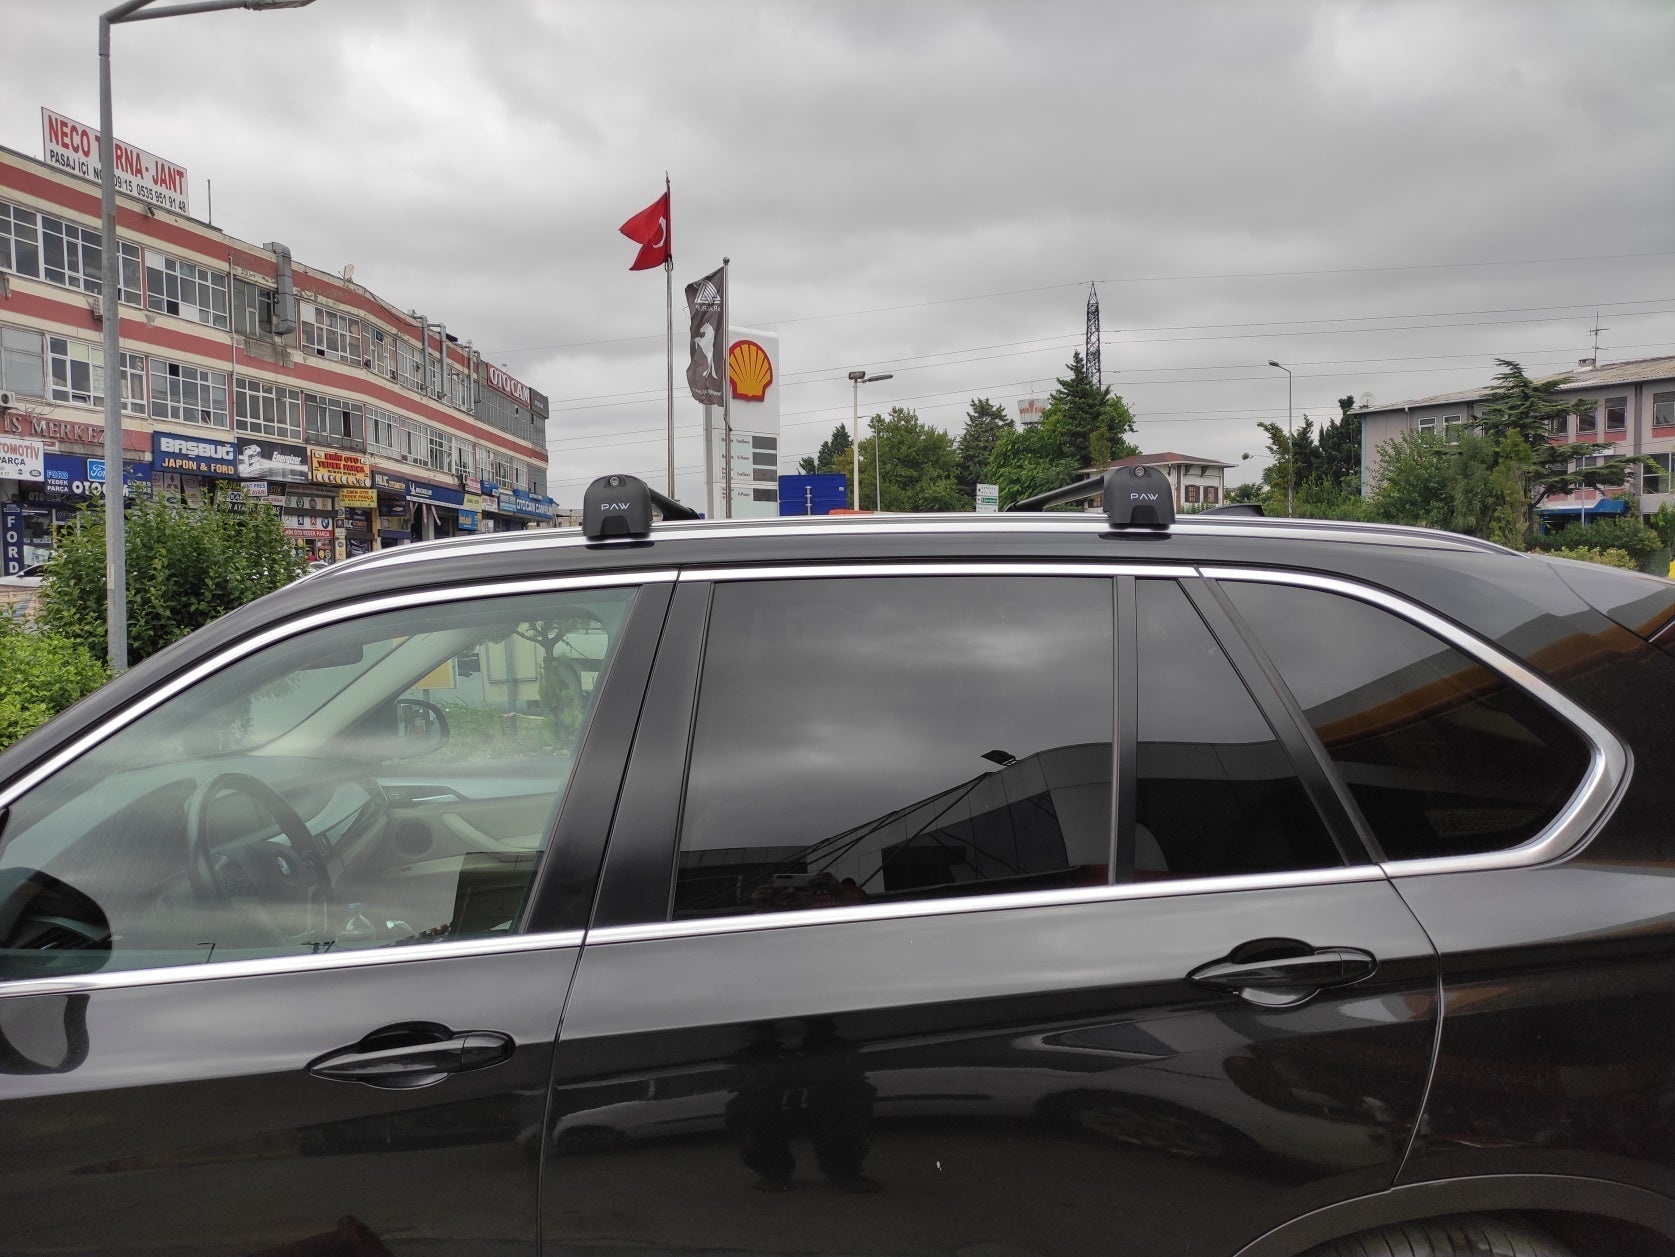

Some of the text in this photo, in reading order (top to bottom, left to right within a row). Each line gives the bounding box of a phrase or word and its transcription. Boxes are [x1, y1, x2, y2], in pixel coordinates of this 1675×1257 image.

[48, 114, 91, 158] NECO
[95, 134, 144, 180] TRNA
[152, 160, 184, 195] JANT
[49, 149, 76, 171] PASAJ
[78, 157, 89, 178] İÇİ
[137, 183, 154, 201] 0535
[154, 191, 167, 205] 951
[168, 196, 177, 210] 91
[490, 367, 511, 394] OTO
[160, 438, 234, 461] BAŞBUĞ
[272, 451, 302, 465] Energizer
[0, 456, 26, 467] ARÇA
[162, 458, 234, 475] JAPON & FORD
[601, 502, 631, 511] PAW
[1130, 493, 1159, 501] PAW
[7, 516, 20, 574] FORD
